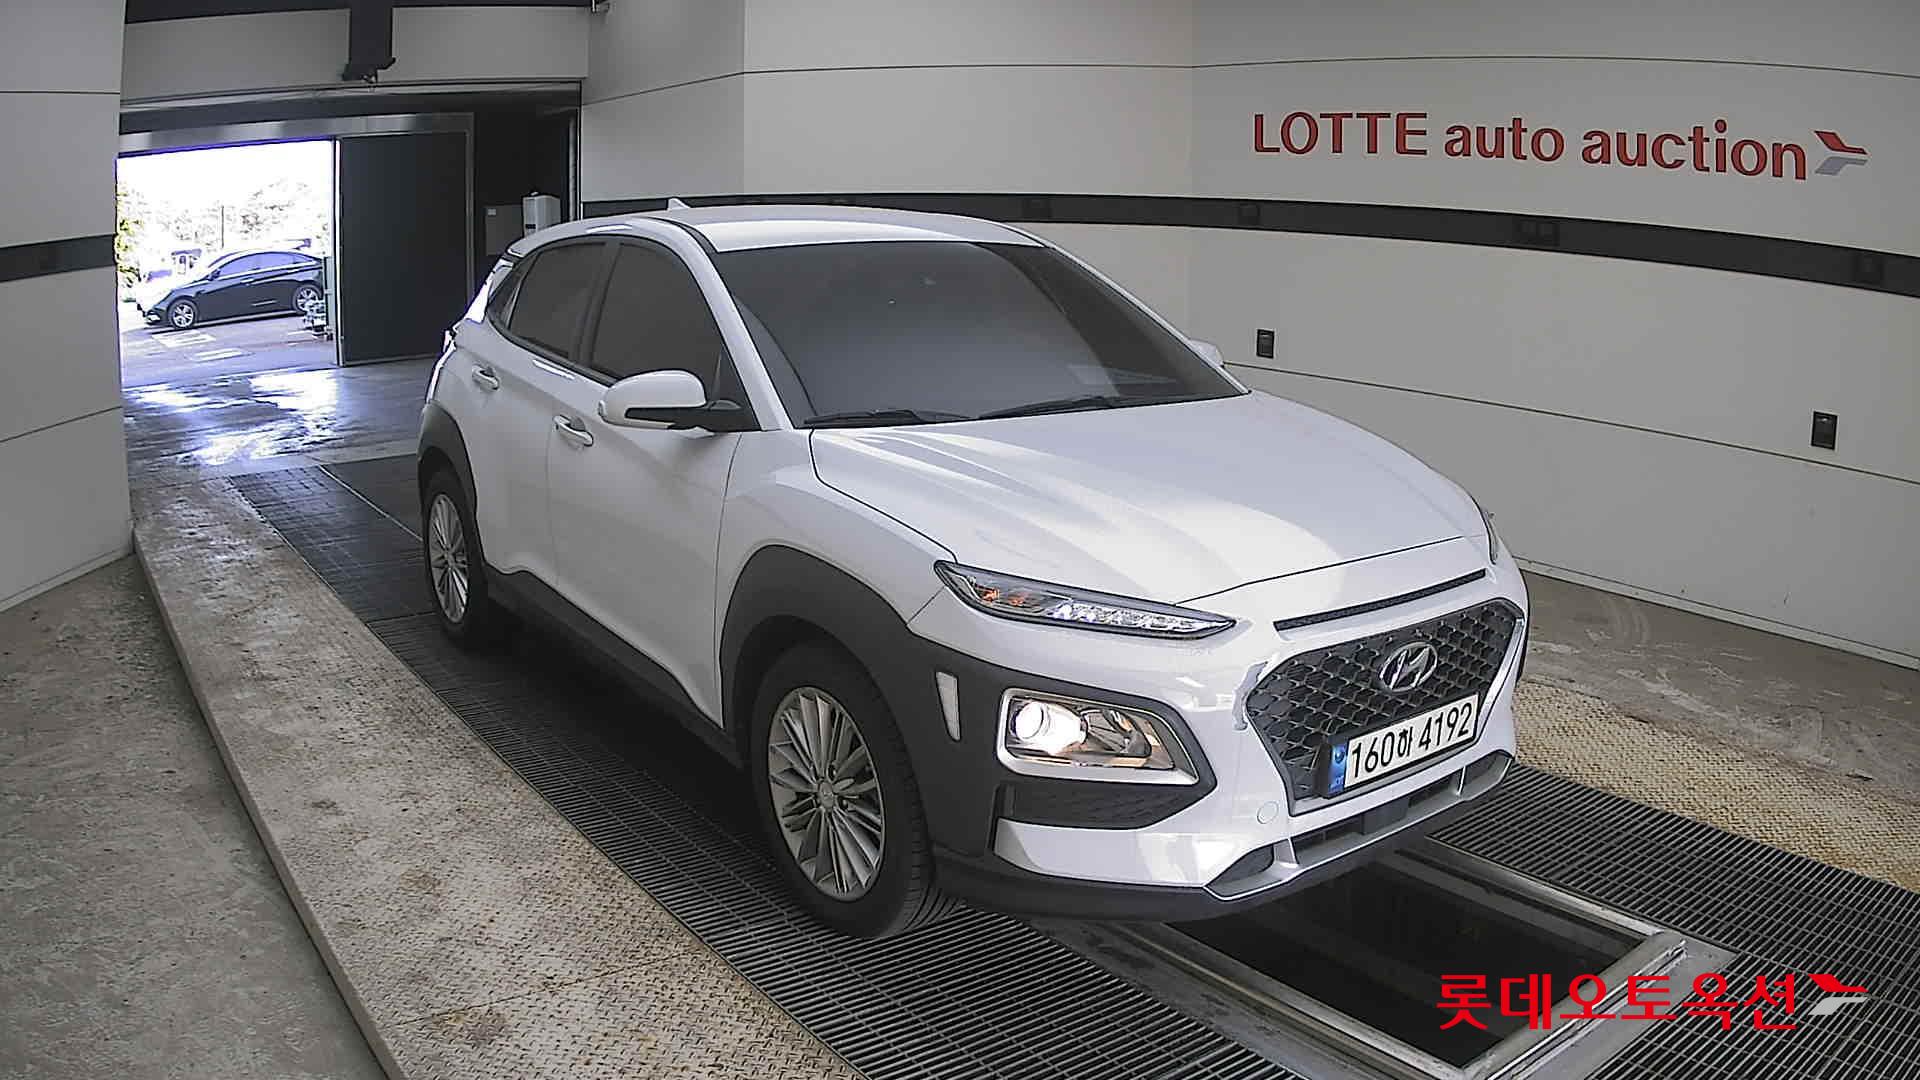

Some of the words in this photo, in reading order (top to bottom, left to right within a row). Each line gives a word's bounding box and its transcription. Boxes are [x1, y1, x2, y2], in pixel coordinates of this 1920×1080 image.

[1253, 112, 1428, 156] LOTTE
[1444, 117, 1565, 162] auto
[1582, 119, 1808, 180] auction
[1351, 725, 1414, 778] 160하
[1418, 702, 1473, 751] 4192
